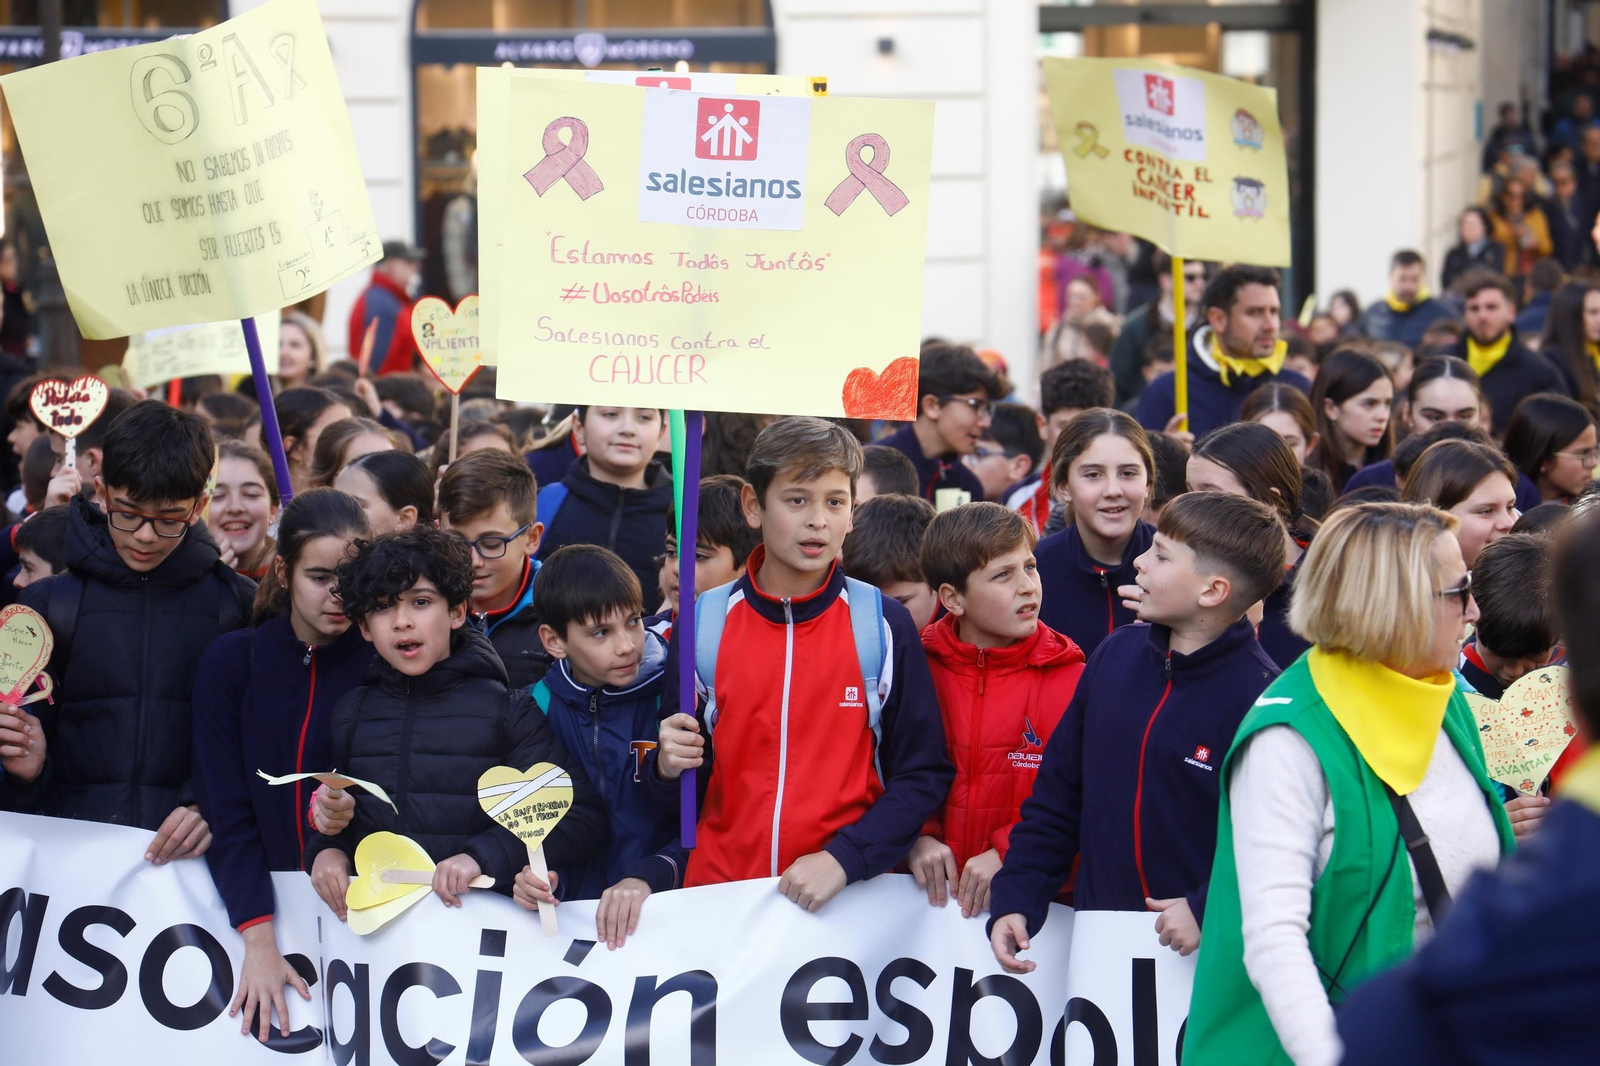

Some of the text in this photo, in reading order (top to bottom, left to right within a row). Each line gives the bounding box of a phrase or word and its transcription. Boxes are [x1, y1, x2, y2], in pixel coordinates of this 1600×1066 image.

[1124, 113, 1204, 142] salesianos
[175, 159, 197, 184] NO
[203, 147, 251, 181] SABEMOS
[1194, 166, 1214, 183] EL
[645, 167, 802, 200] salesianos
[142, 178, 265, 224] QUE SOMOS HASTA QUE
[686, 204, 759, 223] CÓRDOBA
[199, 221, 282, 261] SER FUERTES ES
[126, 267, 212, 307] LA ÚNICA OPCIÓN
[421, 335, 479, 350] VALIENT
[533, 315, 661, 349] Salesianos
[747, 333, 771, 350] el
[1470, 683, 1566, 718] GUAL CUANTA
[1494, 722, 1509, 732] OS
[1486, 750, 1511, 761] MPRE
[1486, 753, 1552, 779] LEVANTAR
